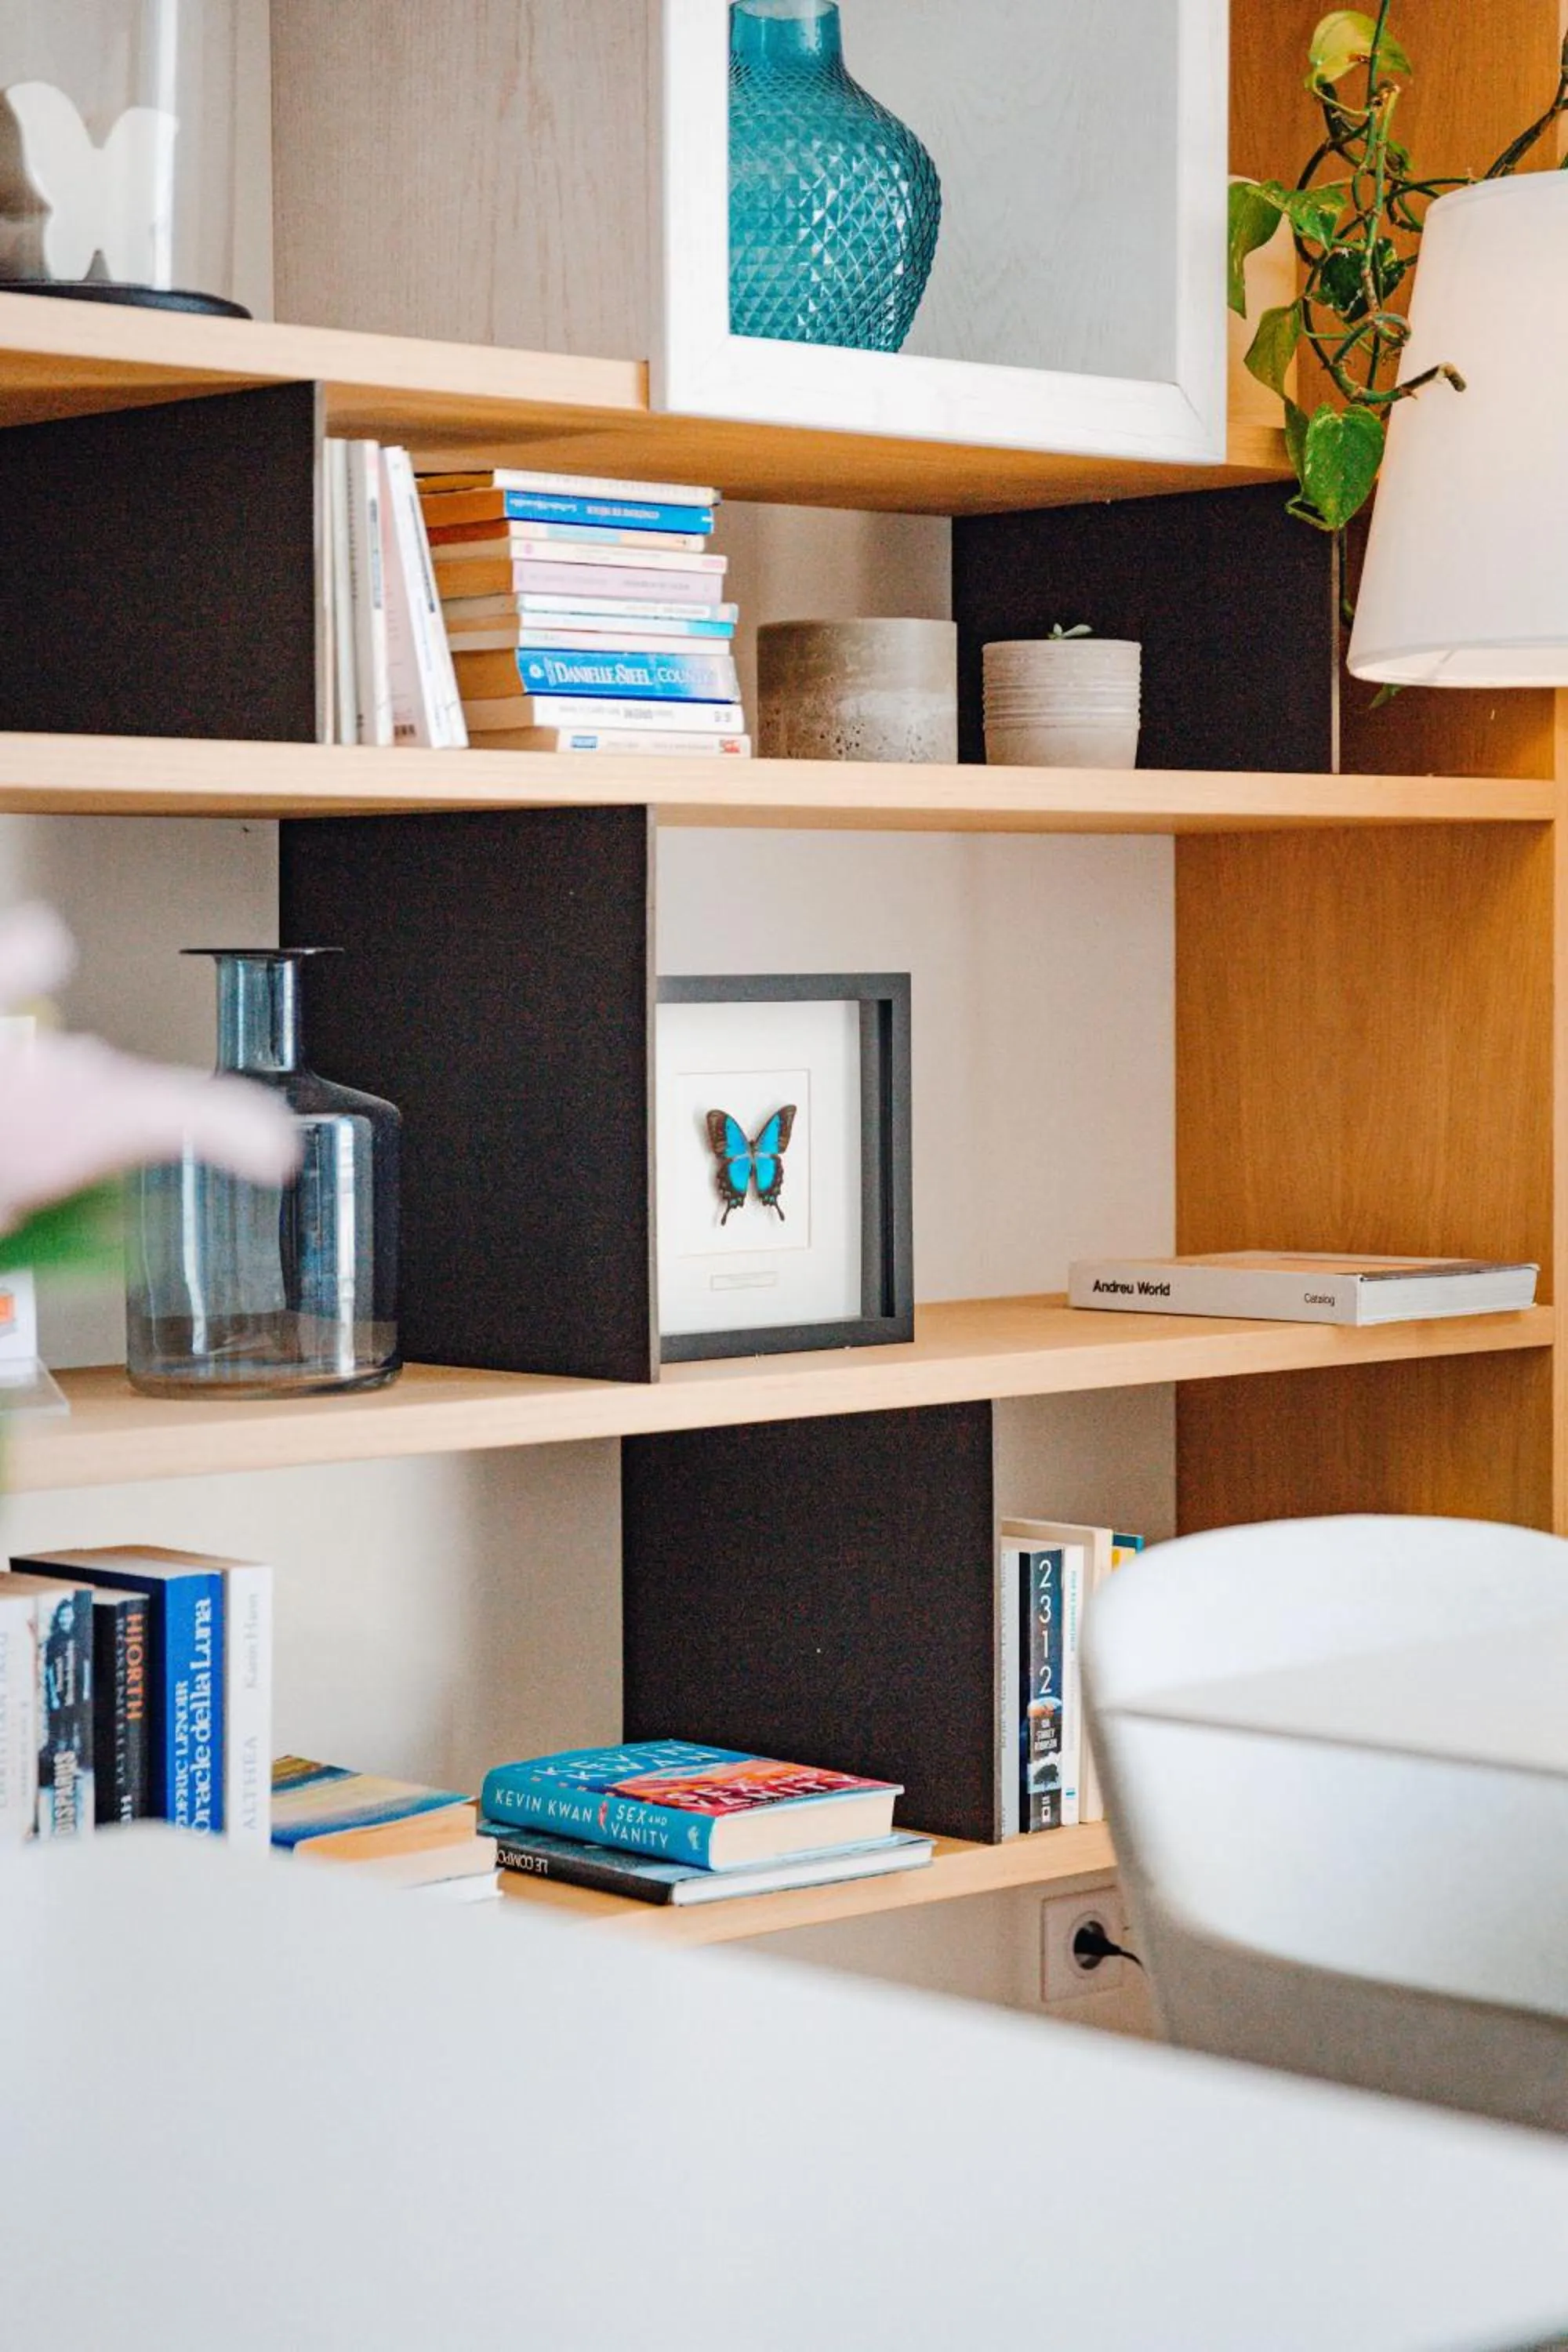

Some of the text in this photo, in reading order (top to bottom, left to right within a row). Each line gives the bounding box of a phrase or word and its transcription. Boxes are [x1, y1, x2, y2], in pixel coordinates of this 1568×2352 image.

[1092, 1279, 1171, 1298] Andreu World
[1304, 1293, 1335, 1307] Catalog
[190, 1597, 212, 1668] Luna
[1038, 1559, 1053, 1694] 2312
[126, 1612, 145, 1721] HJORTH
[190, 1672, 212, 1742] della
[495, 1788, 593, 1823] KEVIN KWAN
[615, 1804, 647, 1824] SEX
[611, 1822, 669, 1849] VANITY
[535, 1857, 549, 1875] LE
